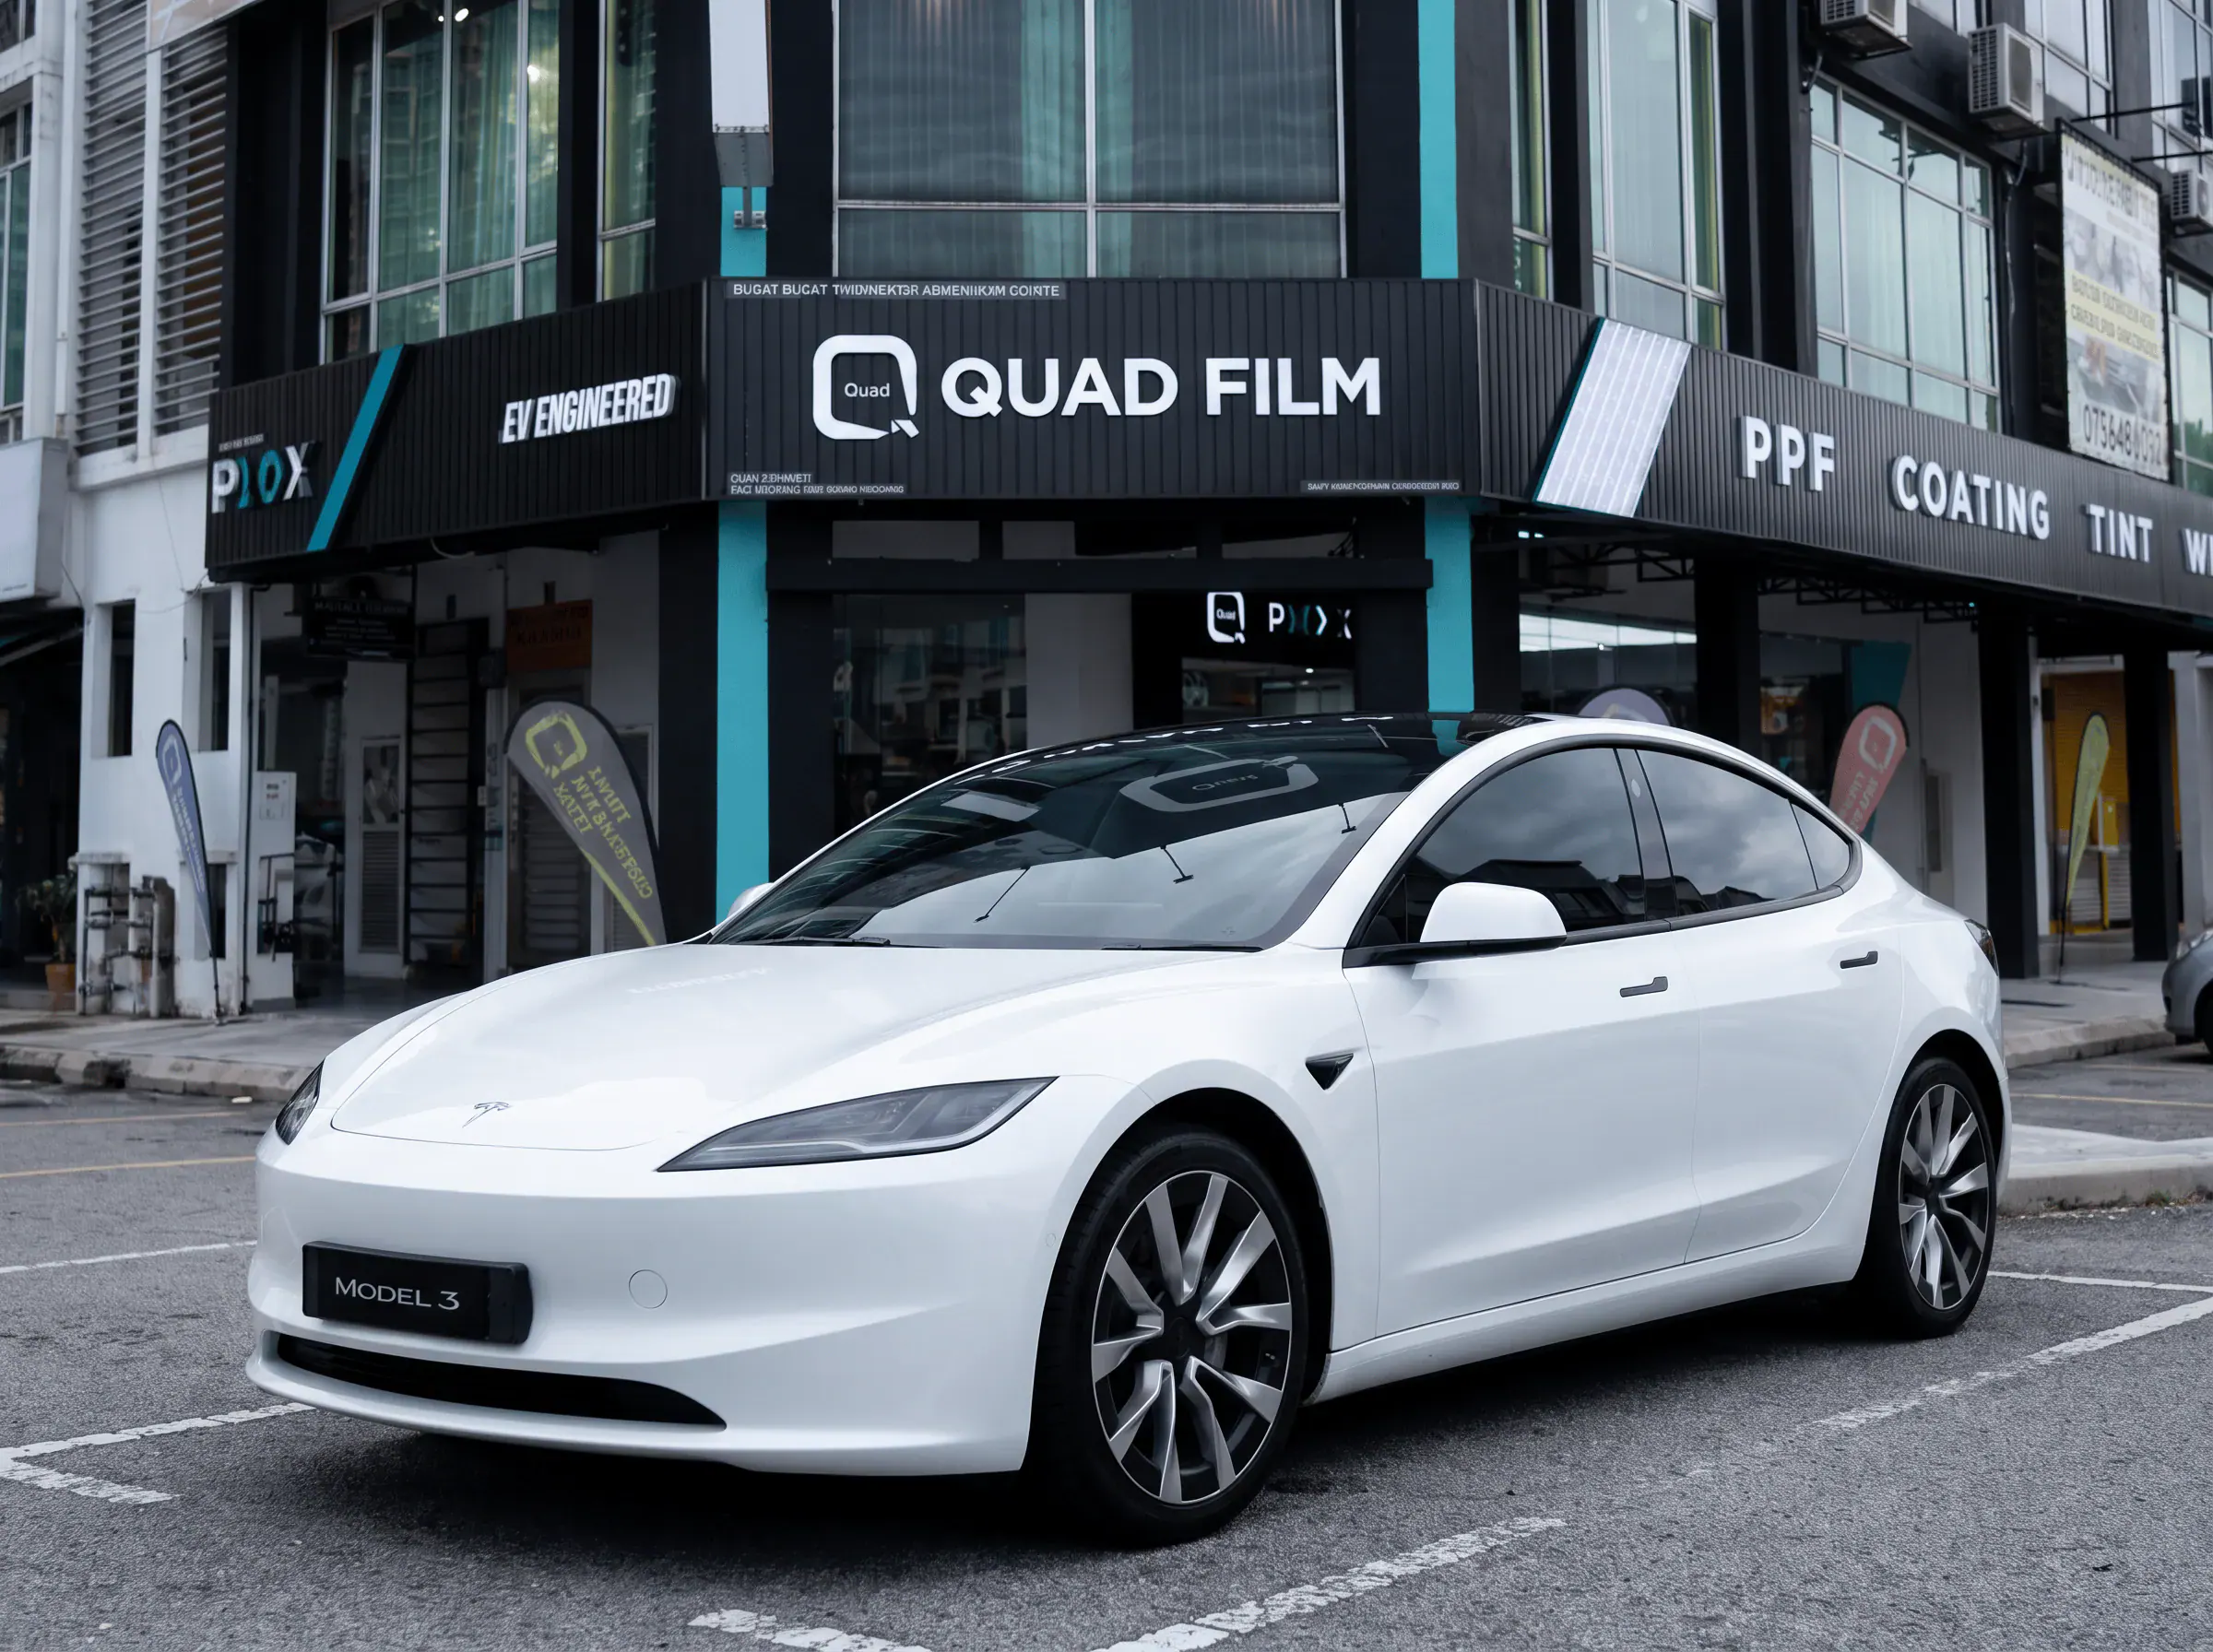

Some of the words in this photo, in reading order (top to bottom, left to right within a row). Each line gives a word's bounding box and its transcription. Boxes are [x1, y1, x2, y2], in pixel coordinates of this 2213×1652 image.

[733, 283, 779, 295] BUGAT
[503, 399, 534, 443] EV
[535, 373, 679, 437] ENGINEERED
[844, 382, 891, 398] Quad
[941, 356, 1178, 418] QUAD
[1205, 356, 1381, 417] FILM
[1737, 415, 1835, 491] PPF
[1891, 454, 2051, 540] COATING
[2083, 503, 2153, 562] TINT
[335, 1277, 432, 1307] MODEL
[437, 1291, 460, 1311] 3
